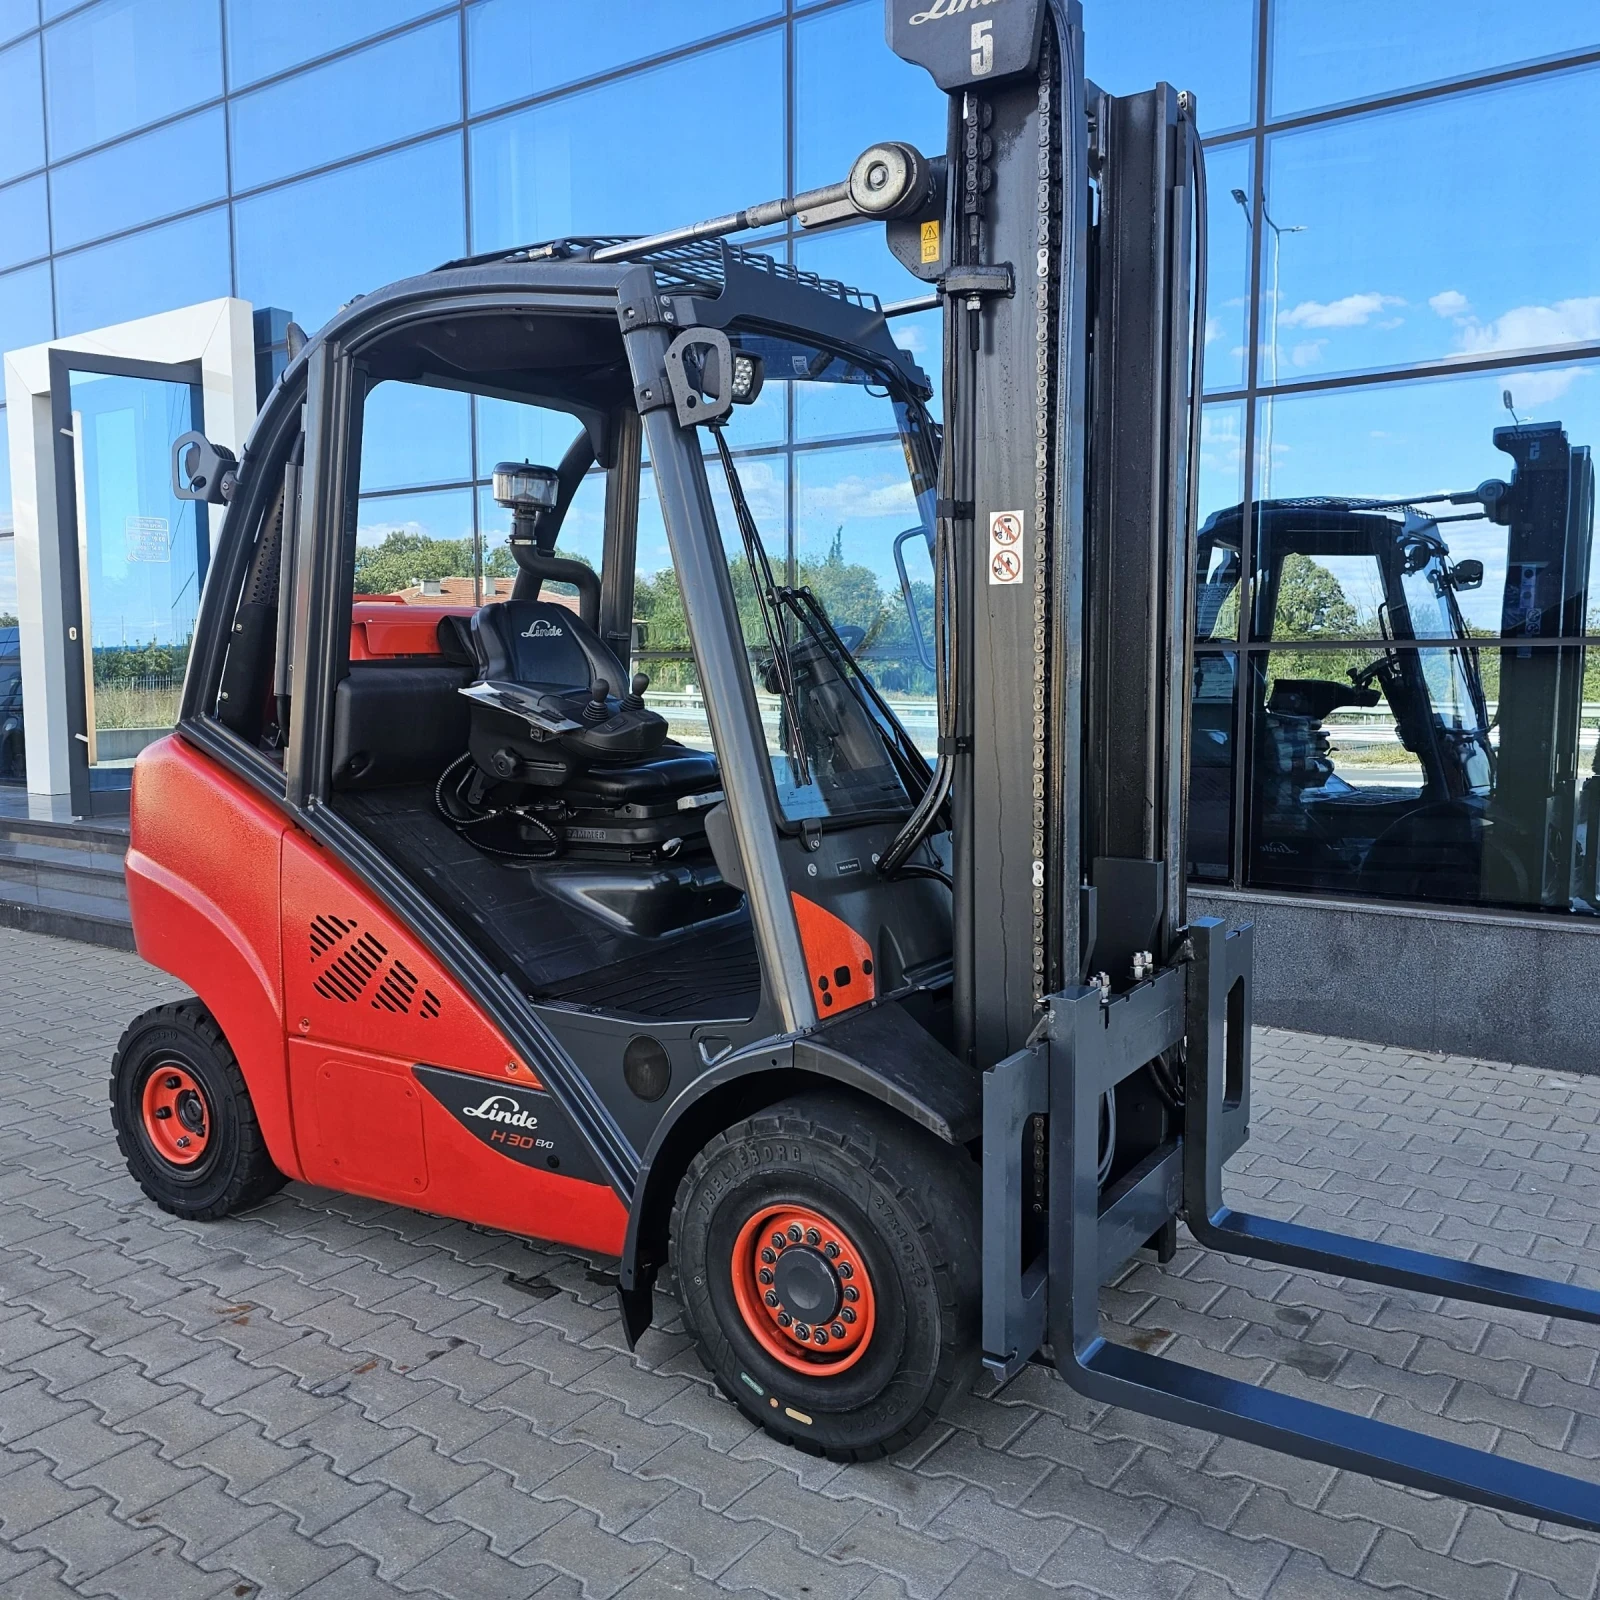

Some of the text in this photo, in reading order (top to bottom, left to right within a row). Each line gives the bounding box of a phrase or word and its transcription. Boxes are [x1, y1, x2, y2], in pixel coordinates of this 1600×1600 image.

[970, 20, 993, 76] 5
[521, 620, 563, 637] Linde
[566, 829, 606, 840] RAMMER
[463, 1095, 538, 1129] Linde
[535, 1139, 554, 1149] EVO
[697, 1143, 801, 1215] TRELLEBORG
